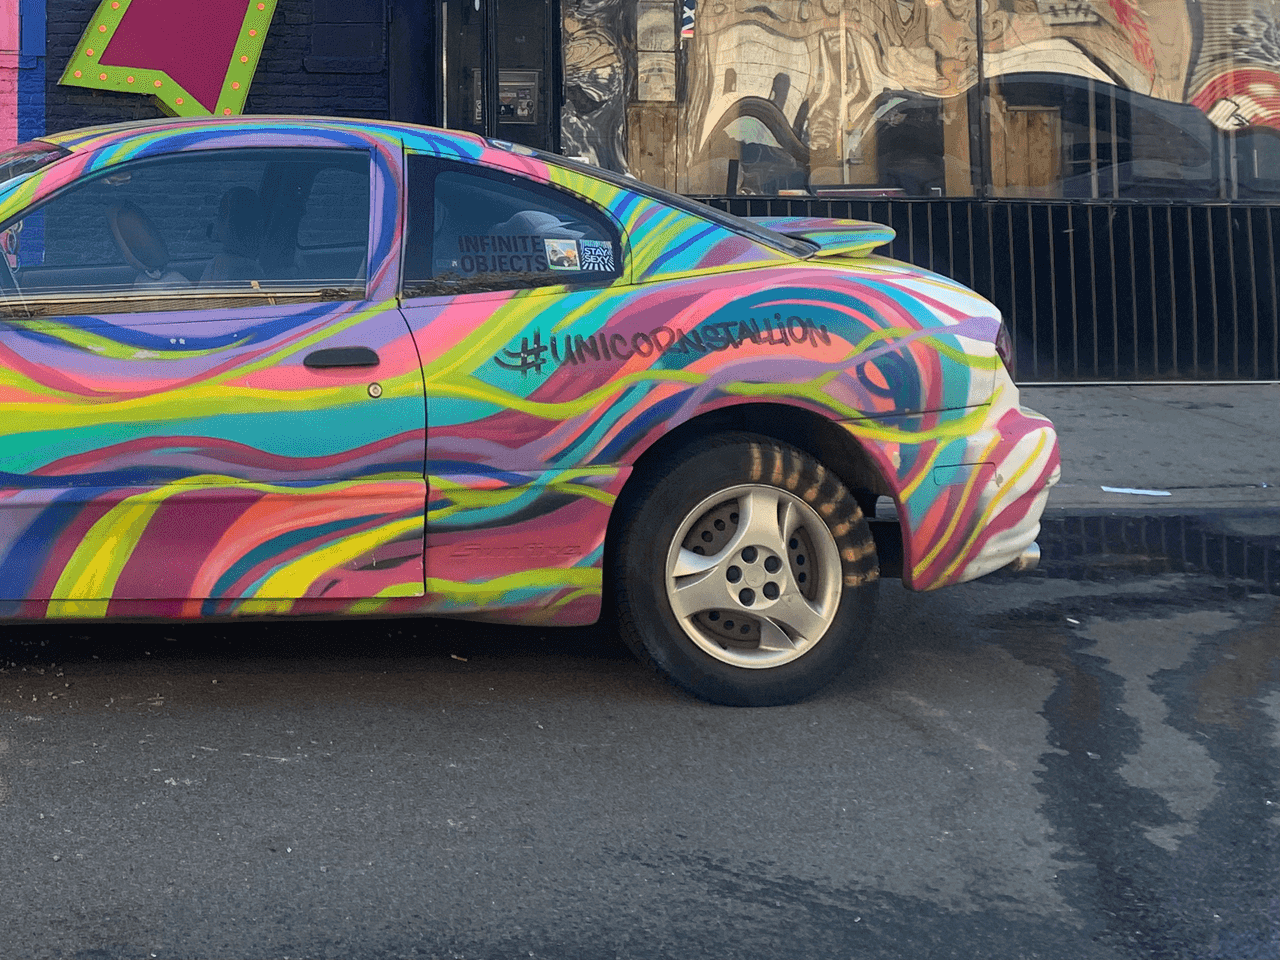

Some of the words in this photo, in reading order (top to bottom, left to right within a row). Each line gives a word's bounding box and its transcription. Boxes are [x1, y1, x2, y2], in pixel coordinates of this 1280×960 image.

[459, 235, 544, 253] INFINITE
[584, 247, 608, 257] STAY
[461, 254, 548, 273] OBJECTS
[584, 255, 610, 265] SEXY
